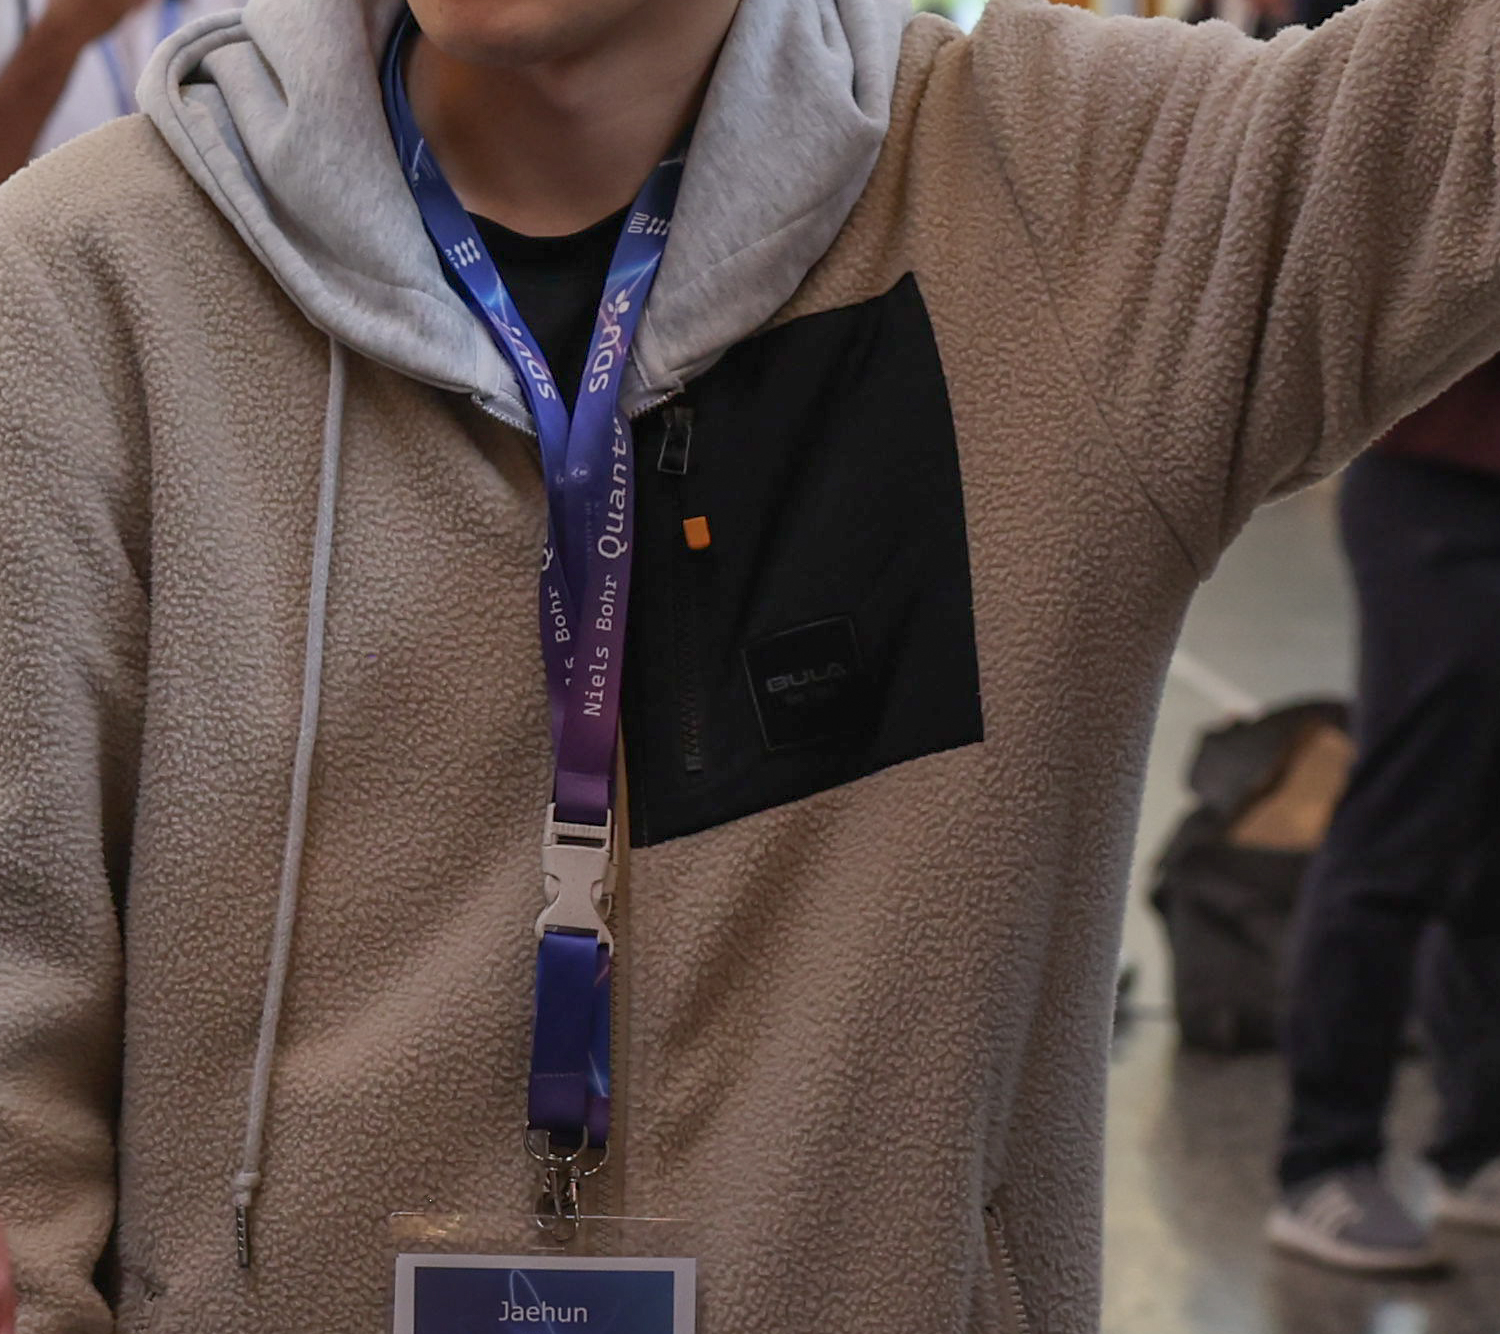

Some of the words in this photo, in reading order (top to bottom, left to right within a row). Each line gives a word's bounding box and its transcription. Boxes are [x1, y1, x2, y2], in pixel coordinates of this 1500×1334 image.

[627, 212, 650, 234] DTU
[588, 324, 622, 394] SDU
[548, 585, 571, 644] Bohr
[596, 574, 618, 631] Bohr
[583, 645, 610, 717] Niels
[498, 1300, 589, 1323] Jaehun
